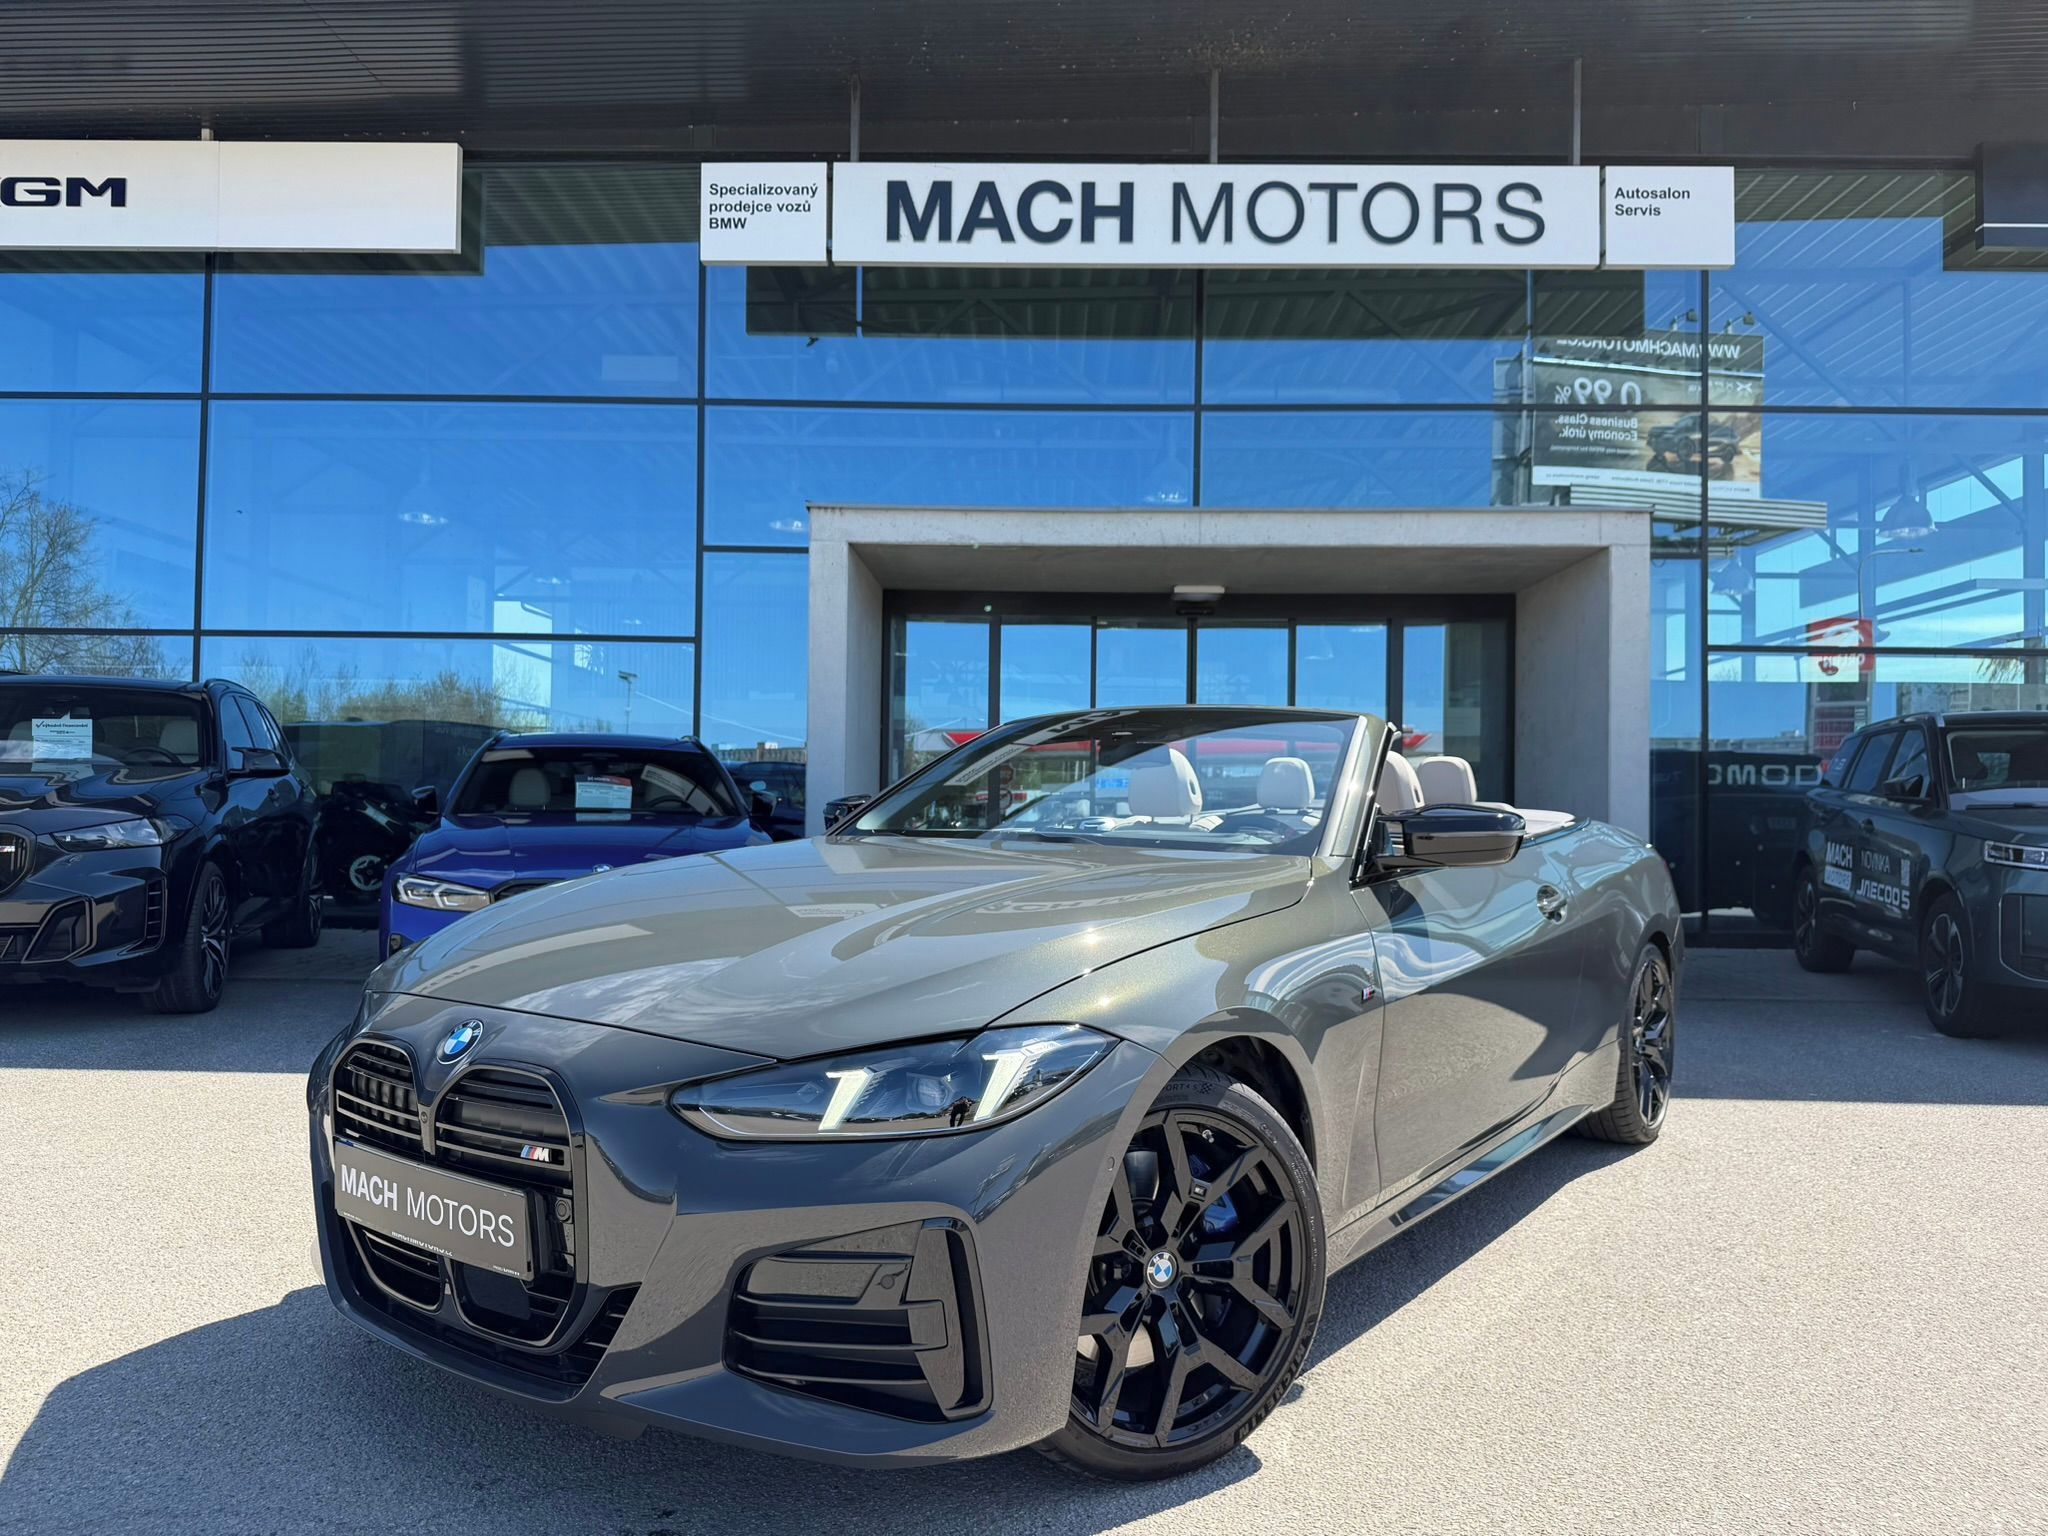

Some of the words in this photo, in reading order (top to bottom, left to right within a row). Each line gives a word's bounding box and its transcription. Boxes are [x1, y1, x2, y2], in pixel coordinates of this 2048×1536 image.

[0, 177, 127, 208] GM
[709, 183, 818, 198] Specializovaný
[1614, 186, 1691, 200] Autosalon
[709, 200, 773, 215] prodejce
[776, 200, 812, 213] vozů
[886, 180, 1135, 244] MACH
[1172, 181, 1546, 245] MOTORS
[1614, 203, 1662, 216] Servis
[709, 217, 747, 230] BMW
[1826, 841, 1853, 868] MACH
[341, 1164, 398, 1212] MACH
[407, 1187, 515, 1248] MOTORS
[1234, 1343, 1306, 1441] MICHELIN
